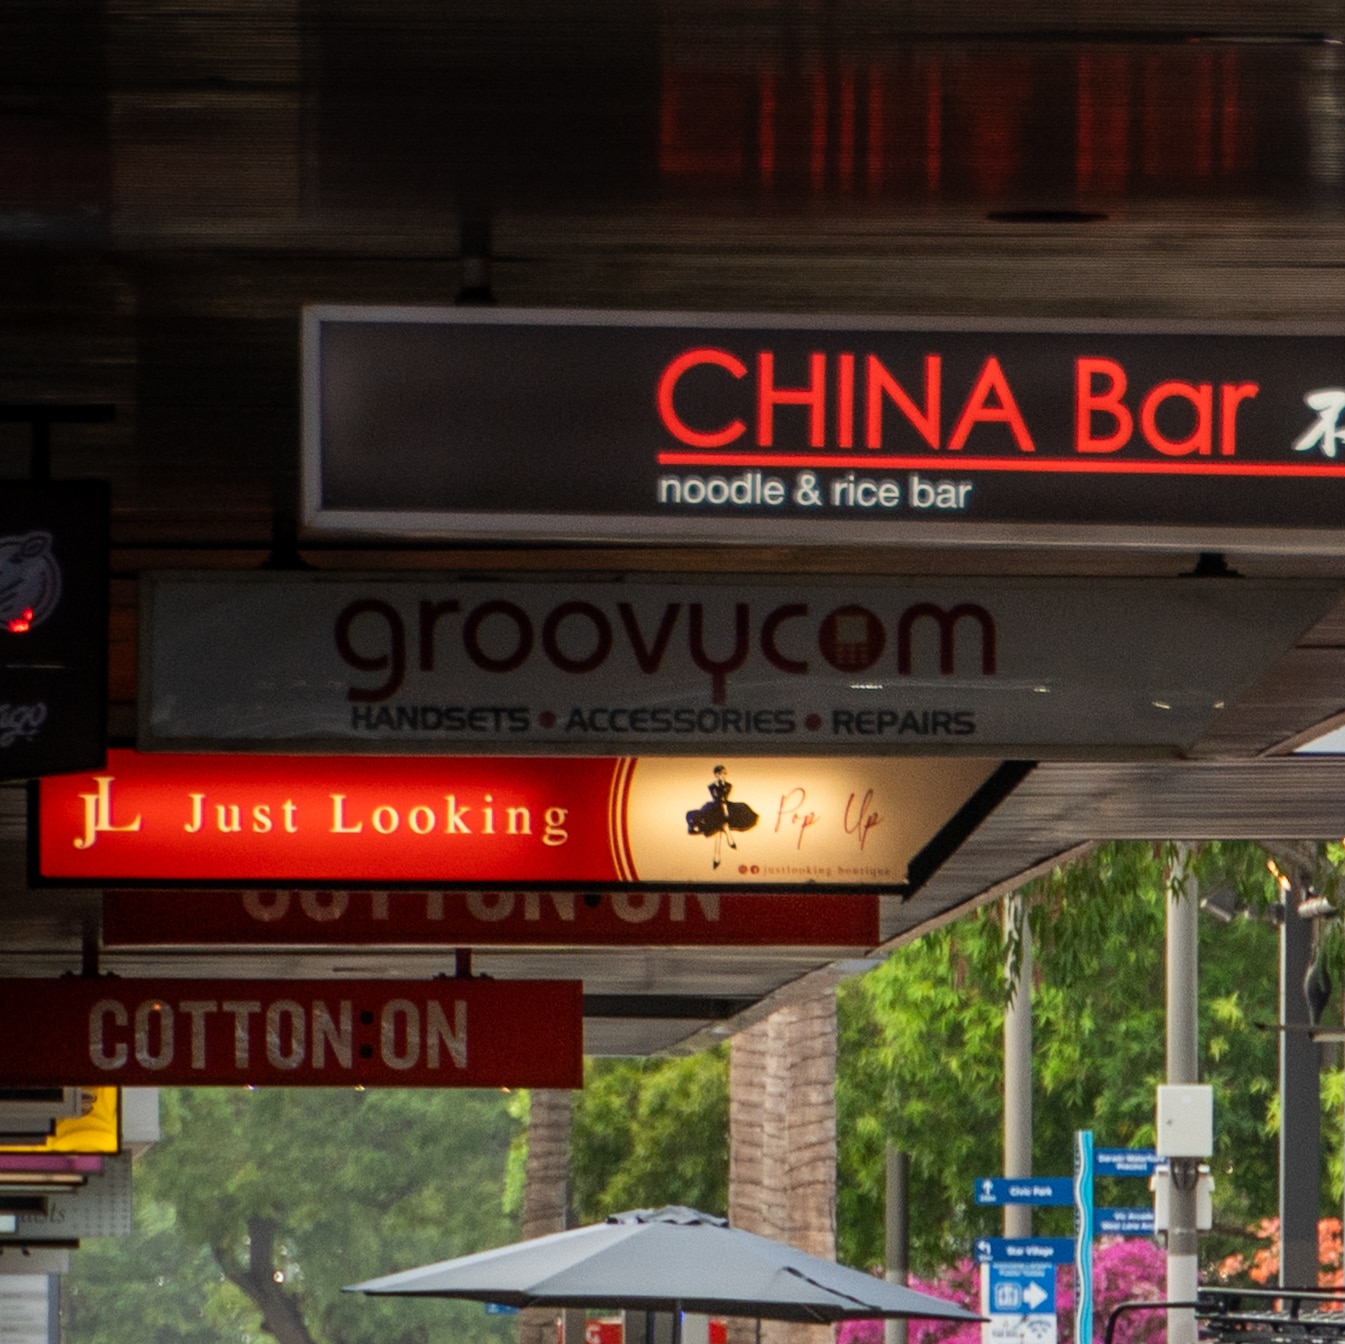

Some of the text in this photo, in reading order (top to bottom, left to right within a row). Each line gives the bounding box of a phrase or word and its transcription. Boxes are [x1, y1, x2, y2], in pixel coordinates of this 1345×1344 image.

[657, 348, 1260, 457] CHINA Bar
[660, 474, 972, 508] noodle & rice bar
[351, 706, 975, 735] HANDSETS ACCESSORIES REPAIRS
[184, 794, 298, 833] Just
[329, 794, 569, 846] Looking
[774, 787, 882, 851] Pop Up
